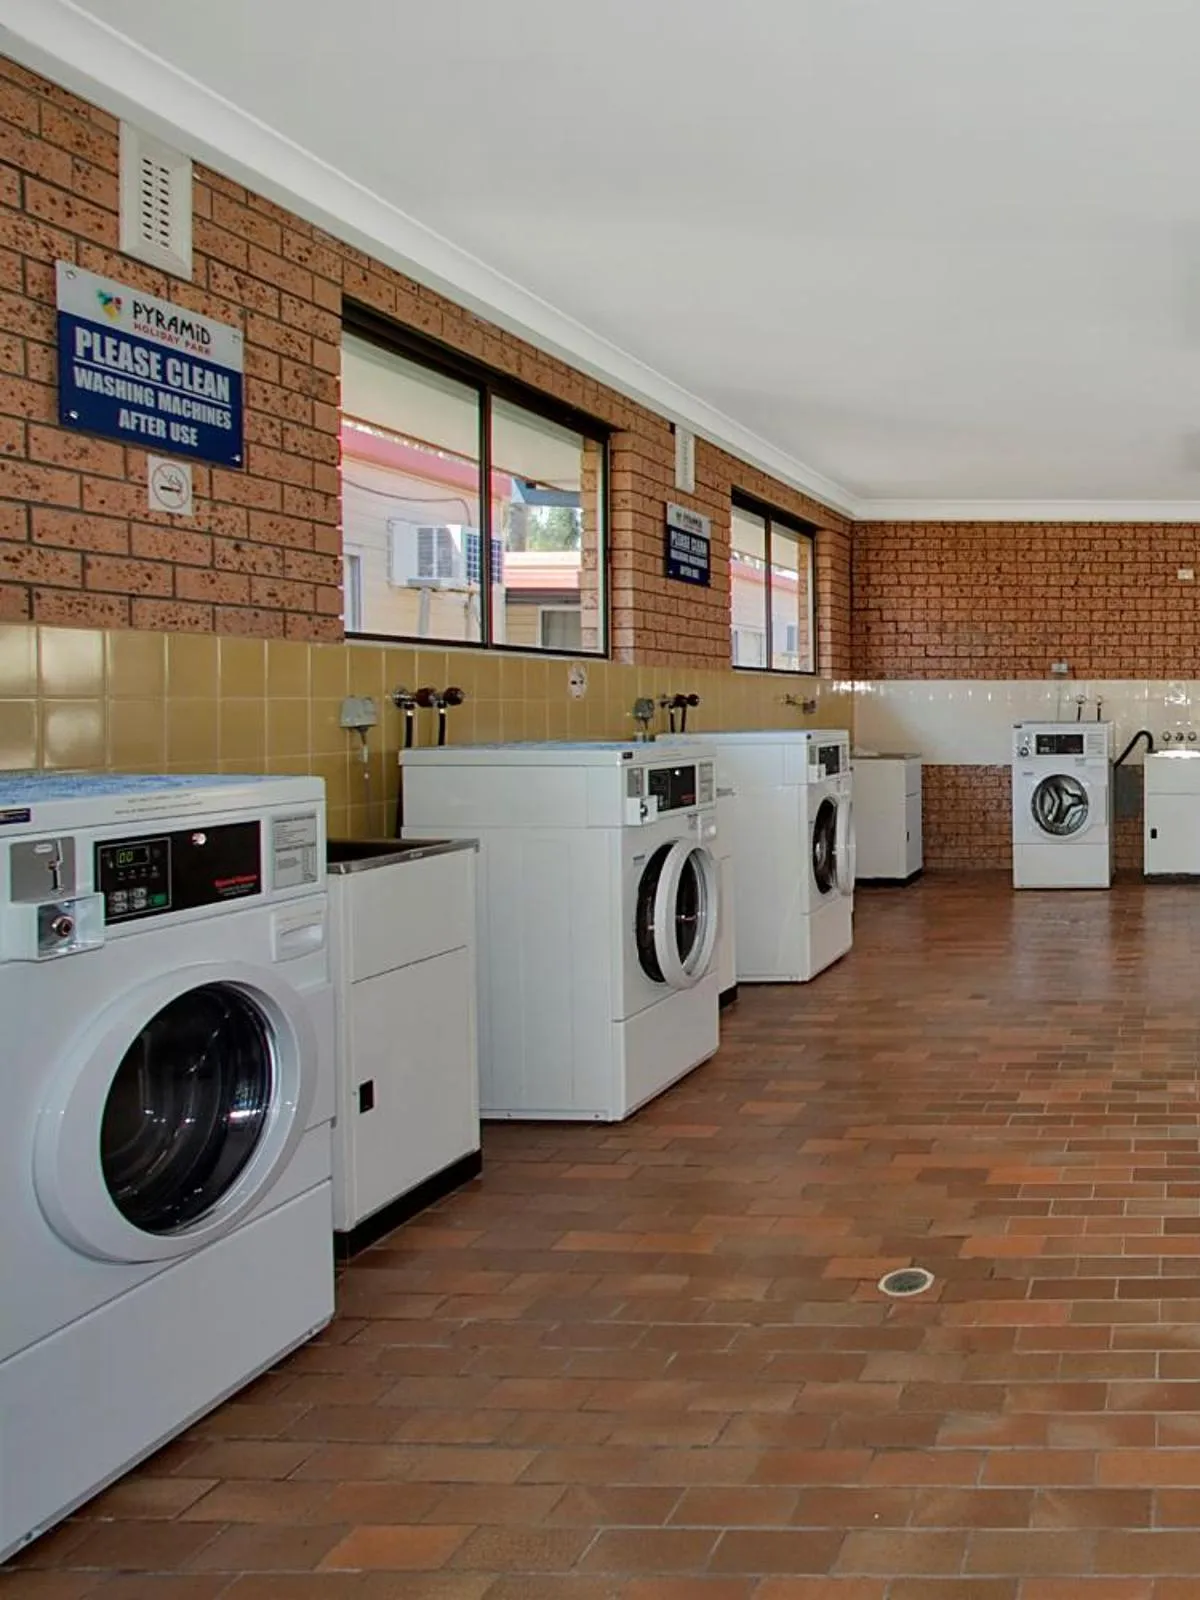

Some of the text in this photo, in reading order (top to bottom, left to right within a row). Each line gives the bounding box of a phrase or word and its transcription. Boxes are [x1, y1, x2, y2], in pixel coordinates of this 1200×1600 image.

[133, 321, 212, 356] HOLIDAY PARK
[75, 326, 230, 403] PLEASE CLEAN
[73, 366, 232, 430] WASHING MACHINES
[119, 408, 199, 447] AFTER USE
